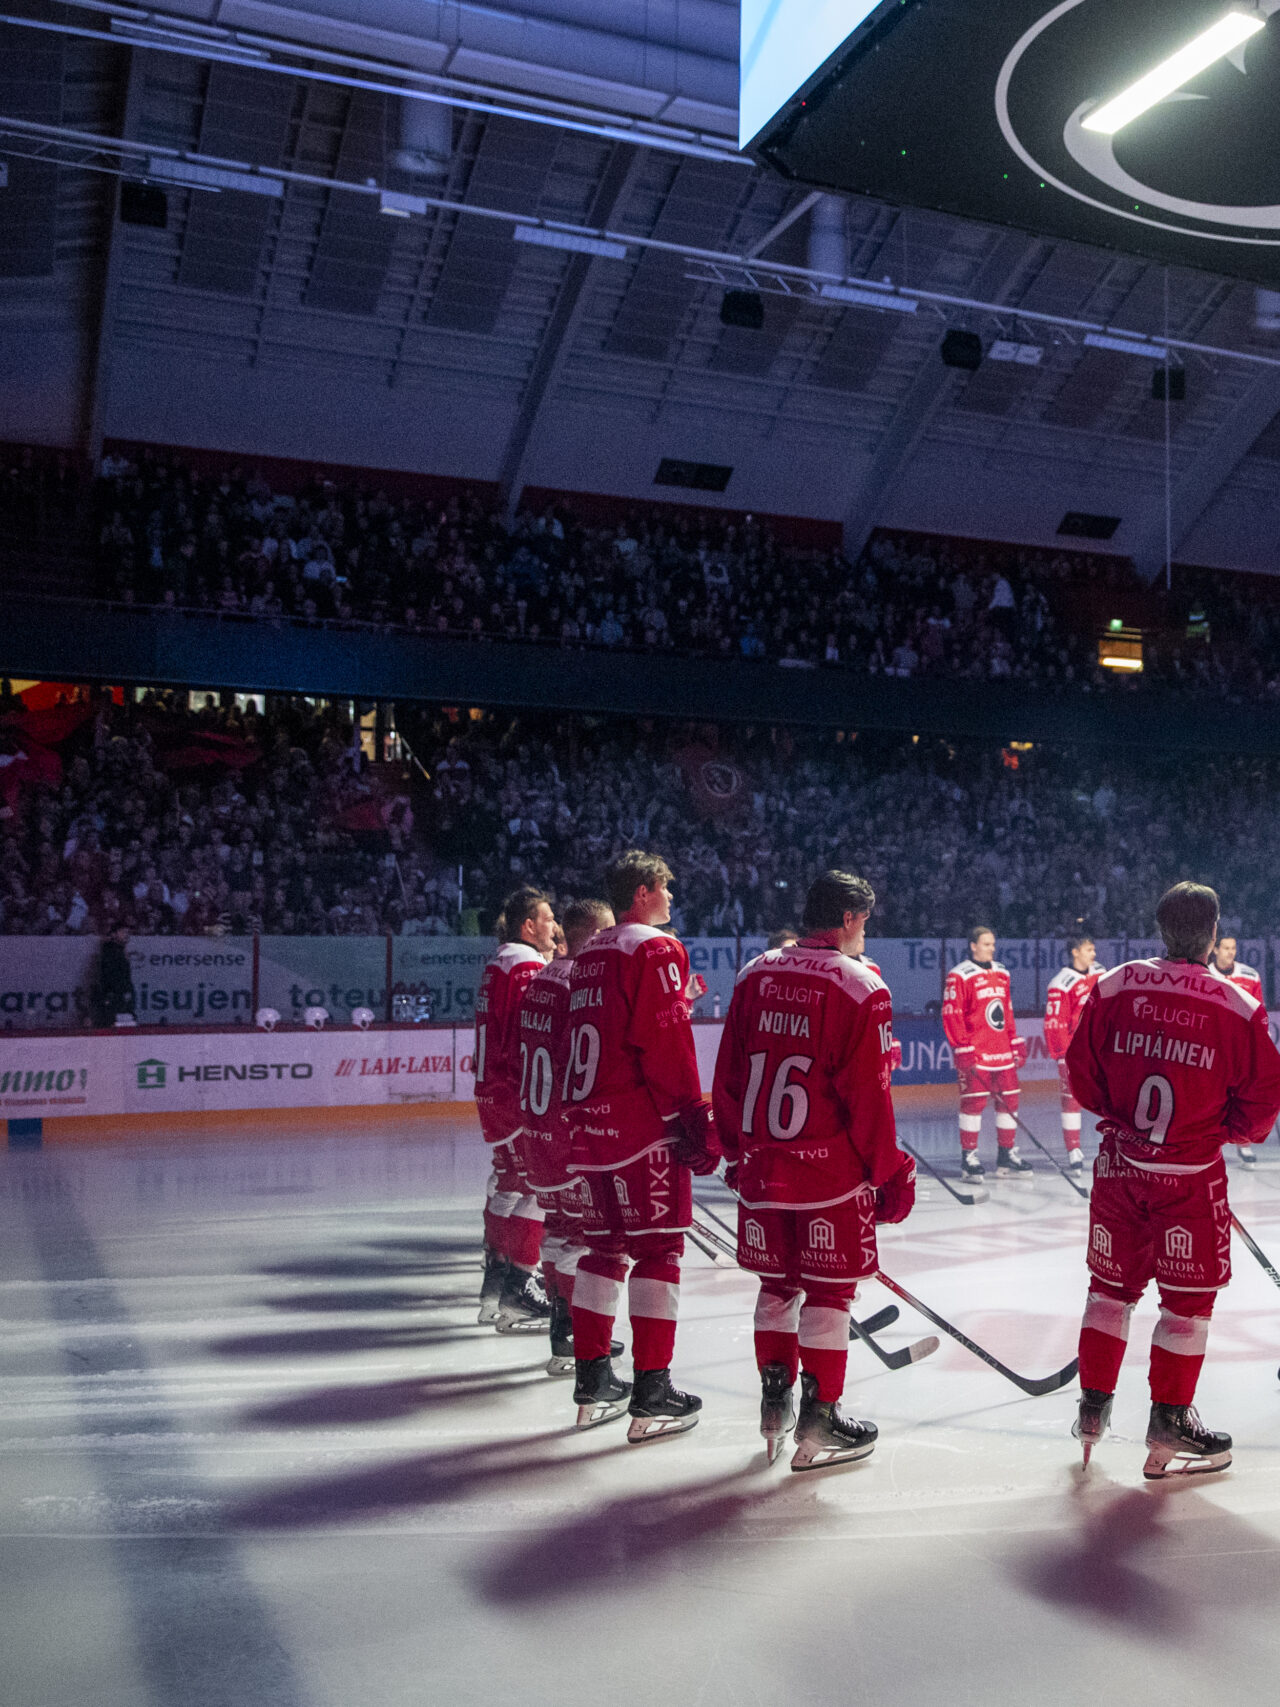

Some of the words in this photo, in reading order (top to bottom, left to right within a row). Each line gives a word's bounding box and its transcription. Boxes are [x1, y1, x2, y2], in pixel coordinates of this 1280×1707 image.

[149, 952, 246, 967] enersense
[656, 962, 682, 994] 19
[766, 983, 825, 1006] PLUGIT
[1123, 965, 1228, 1001] PUUVILLA
[758, 1009, 810, 1039] NOIVA
[1141, 1004, 1210, 1030] PLUGIT
[877, 1019, 892, 1055] 16
[1113, 1029, 1217, 1070] LIPIÄINEN
[178, 1063, 313, 1083] HENSTO
[561, 1023, 601, 1102] 19
[742, 1051, 815, 1140] 16
[1133, 1074, 1175, 1146] 9
[1207, 1177, 1232, 1280] LEXIA
[800, 1249, 848, 1263] ASTORA
[1156, 1257, 1206, 1274] ASTORA
[947, 1325, 998, 1368] VAPOR
